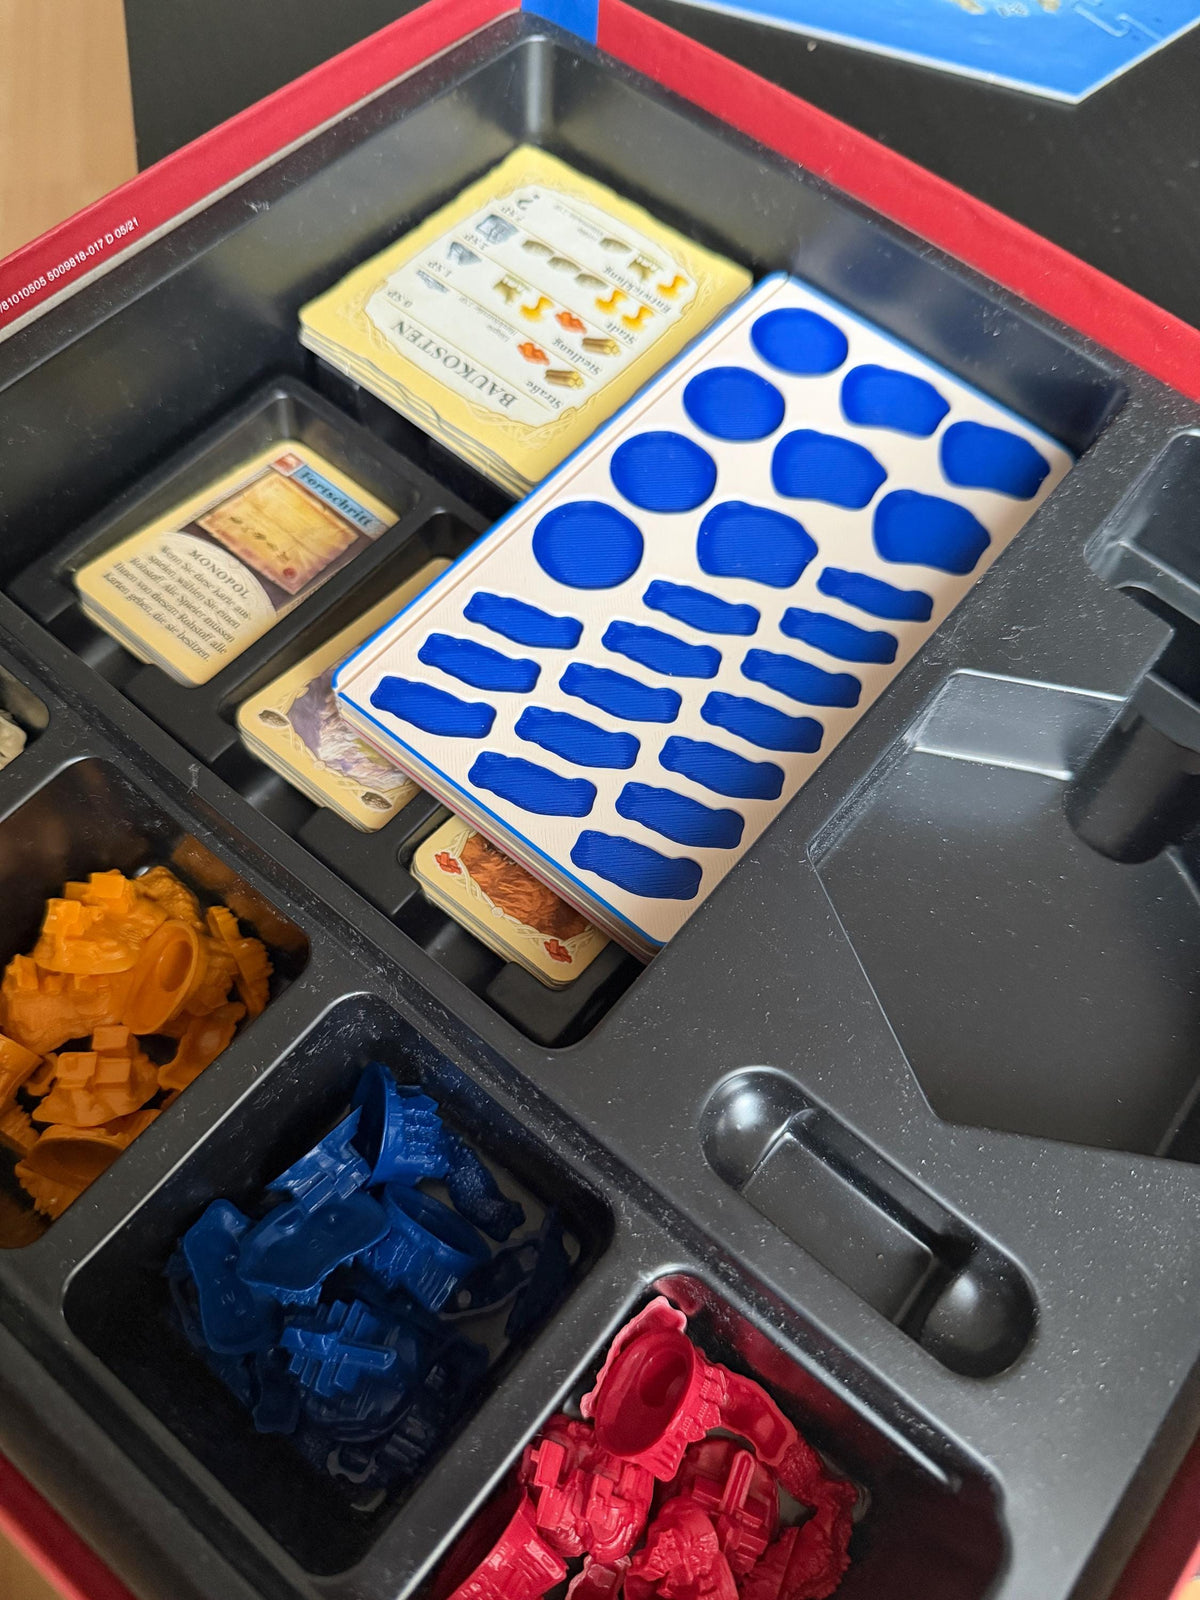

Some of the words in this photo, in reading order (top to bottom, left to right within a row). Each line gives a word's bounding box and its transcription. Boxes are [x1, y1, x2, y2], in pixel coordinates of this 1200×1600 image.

[46, 238, 102, 283] 5009818-017
[105, 232, 115, 245] D
[113, 216, 139, 239] 05/21
[602, 266, 671, 314] Entwicklung
[551, 337, 602, 377] Siedlung
[605, 321, 637, 346] Stadt
[390, 320, 518, 409] BAUKOSTEN
[523, 380, 563, 410] Straße
[301, 471, 373, 526] Fortschritt
[188, 550, 249, 600] MONOPOL
[177, 613, 215, 642] Rohstoff
